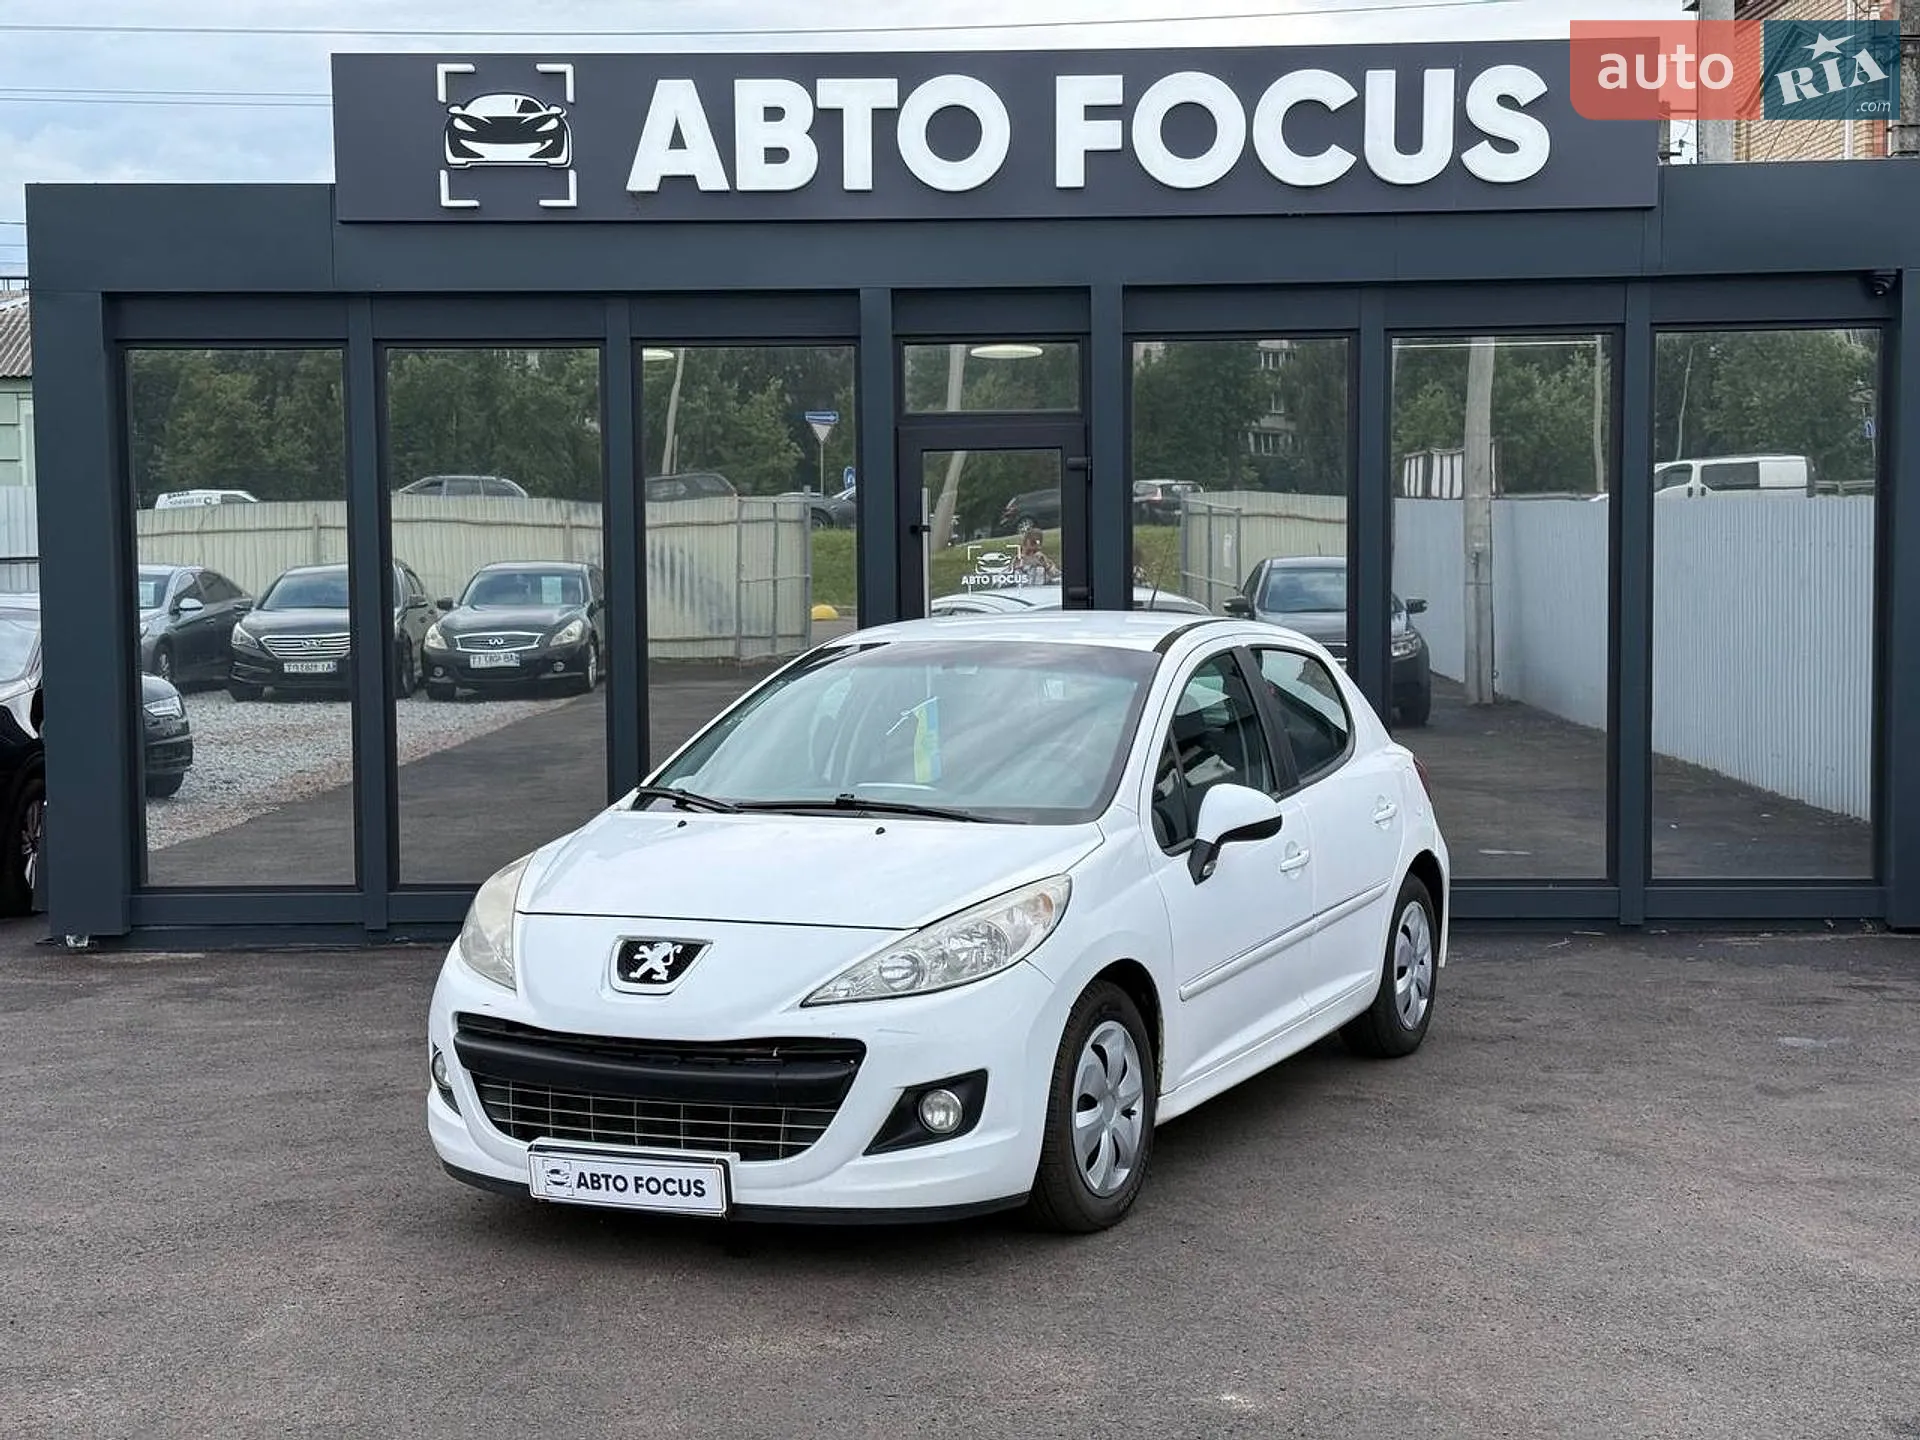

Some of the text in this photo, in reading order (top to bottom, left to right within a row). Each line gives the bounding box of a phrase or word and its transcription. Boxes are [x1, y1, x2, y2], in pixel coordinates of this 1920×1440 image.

[626, 65, 1551, 192] АВТО FOCUS
[961, 574, 1029, 585] АВТО FOCUS
[576, 1171, 706, 1197] АВТО FOCUS
